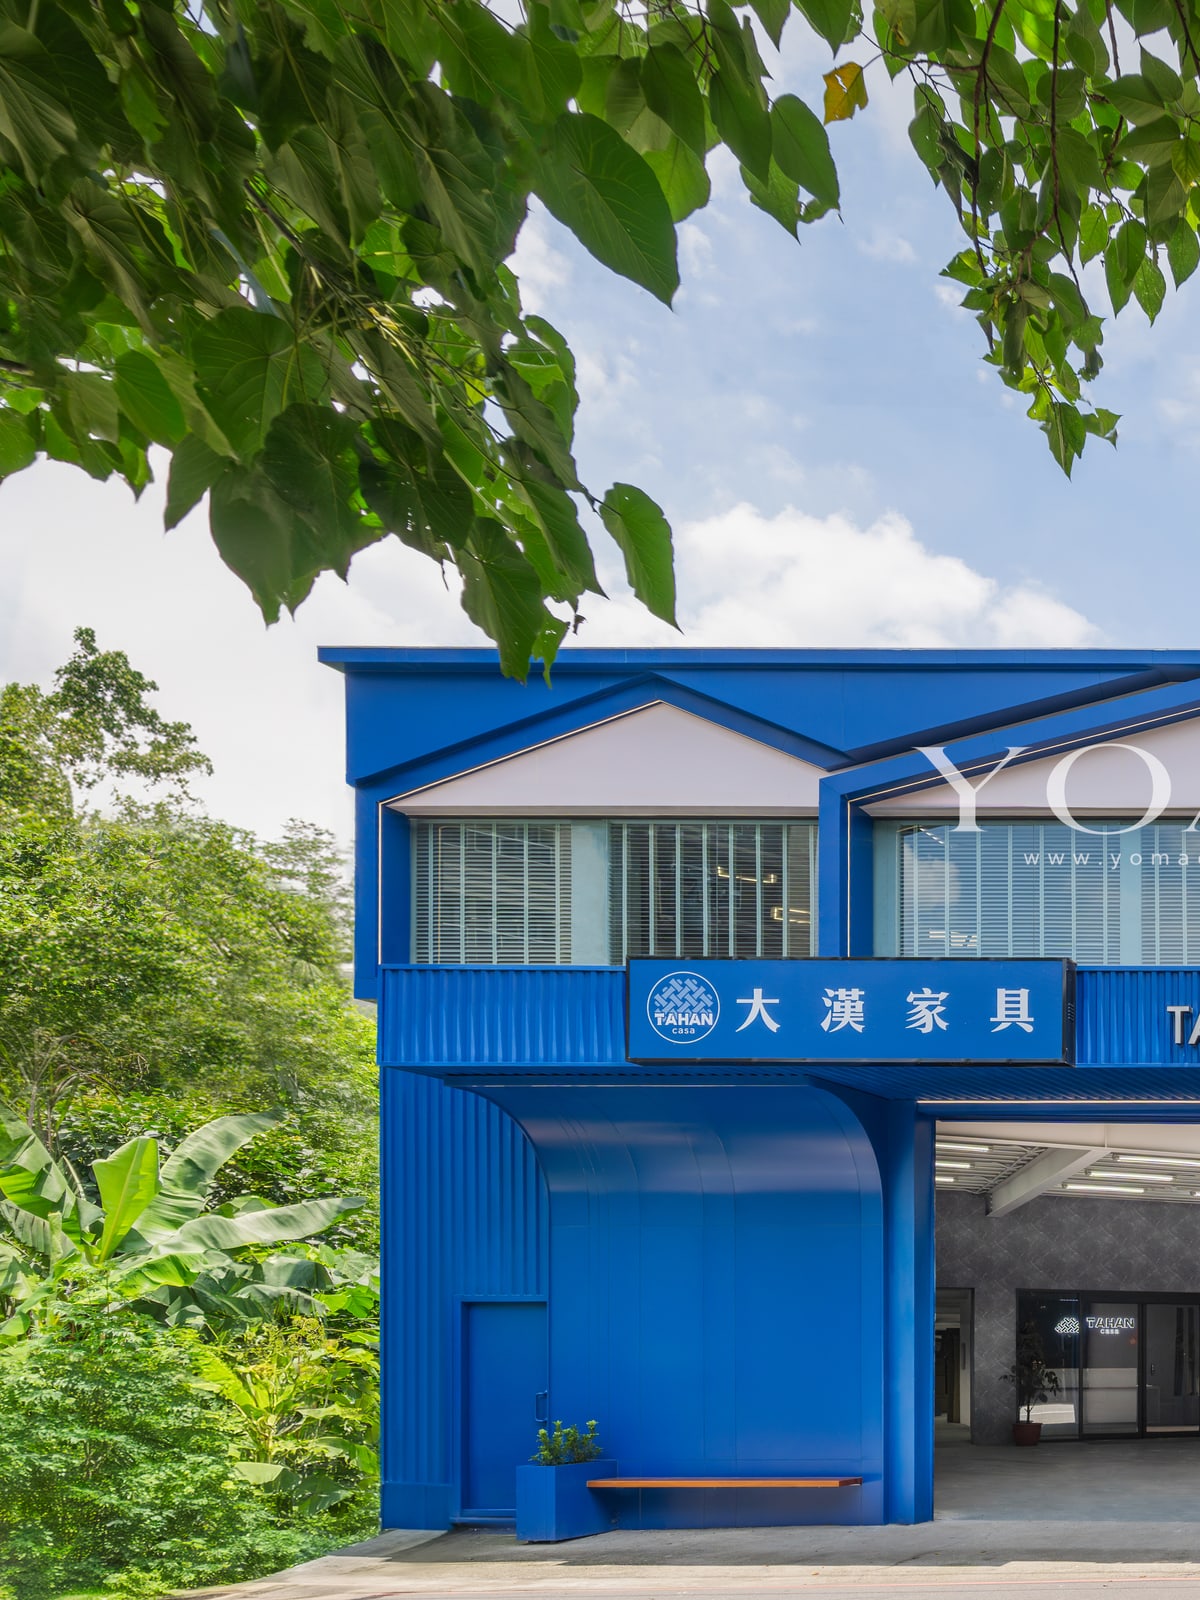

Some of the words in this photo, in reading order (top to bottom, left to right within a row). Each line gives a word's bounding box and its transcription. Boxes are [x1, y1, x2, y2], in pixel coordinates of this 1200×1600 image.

[735, 987, 1035, 1034] 大漢家具
[654, 1013, 713, 1026] TAHAN
[671, 1027, 695, 1035] casa
[1086, 1317, 1135, 1328] TAHAN
